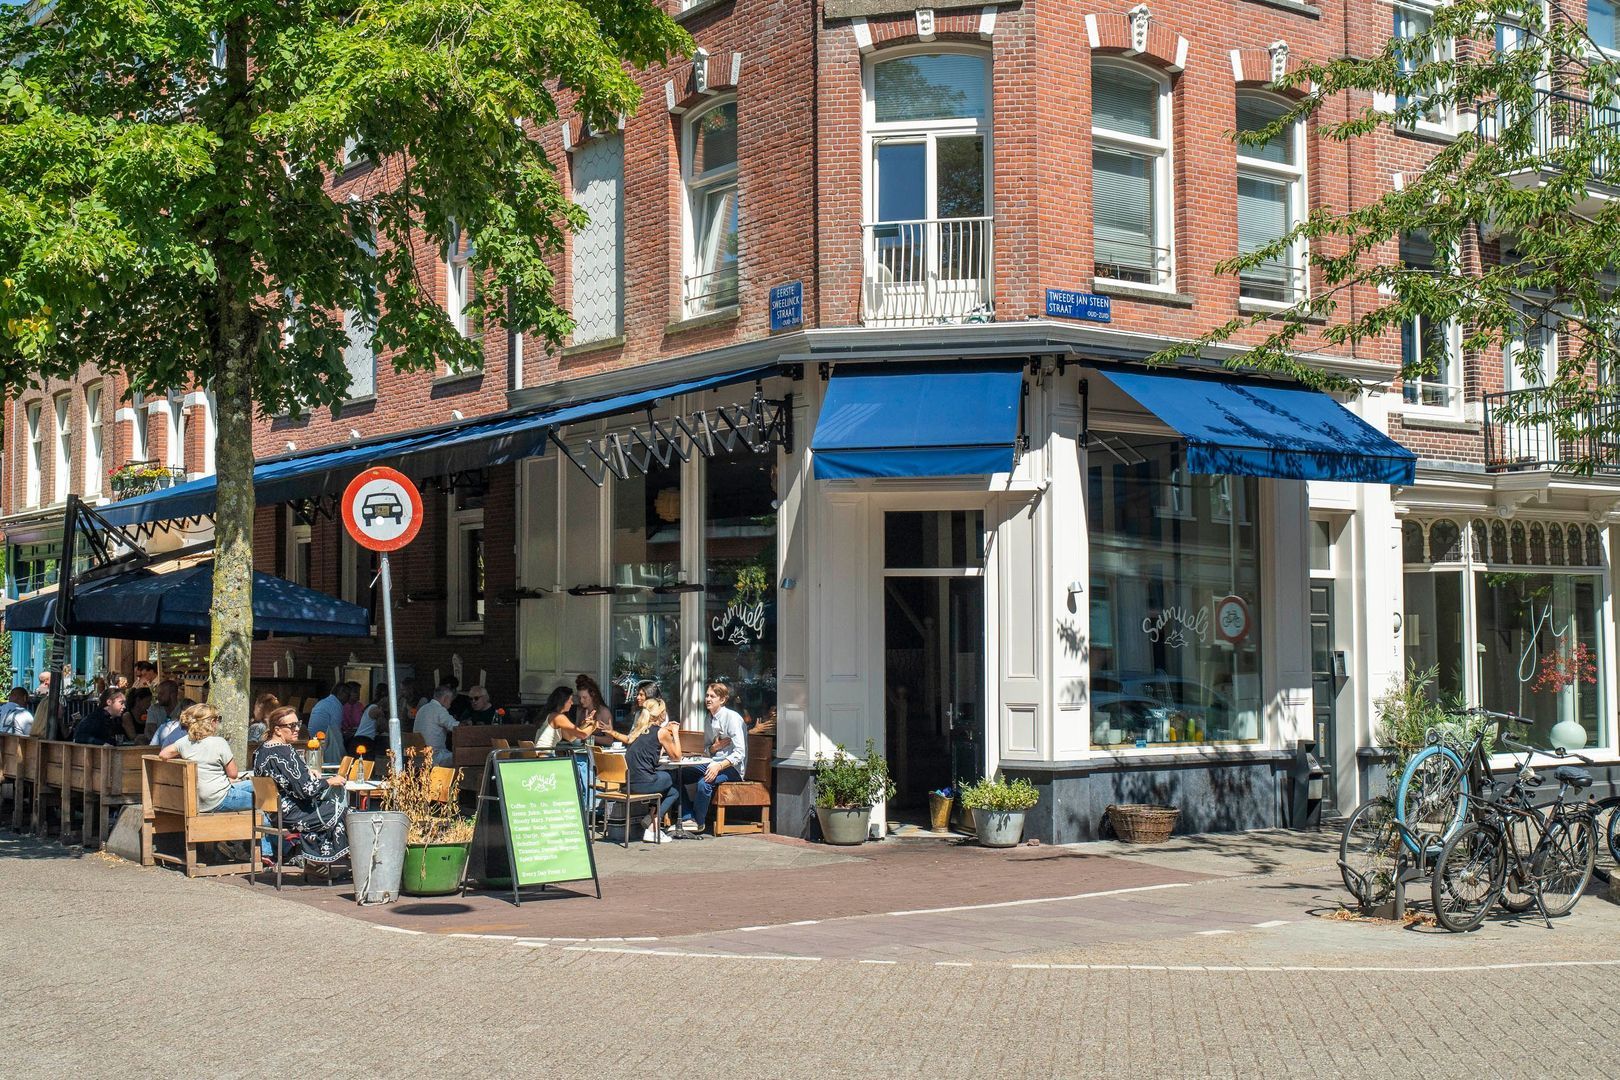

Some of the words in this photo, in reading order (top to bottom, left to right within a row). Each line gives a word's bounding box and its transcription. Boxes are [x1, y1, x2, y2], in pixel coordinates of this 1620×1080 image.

[776, 286, 795, 298] EERSTE
[772, 295, 800, 310] SWEELINCK
[1048, 291, 1075, 304] TWEEDE
[1076, 294, 1088, 306] JAN
[1089, 297, 1109, 308] STEEN
[776, 307, 795, 320] STRAAT
[1048, 303, 1073, 314] STRAAT
[1087, 310, 1110, 319] OUD-ZUID
